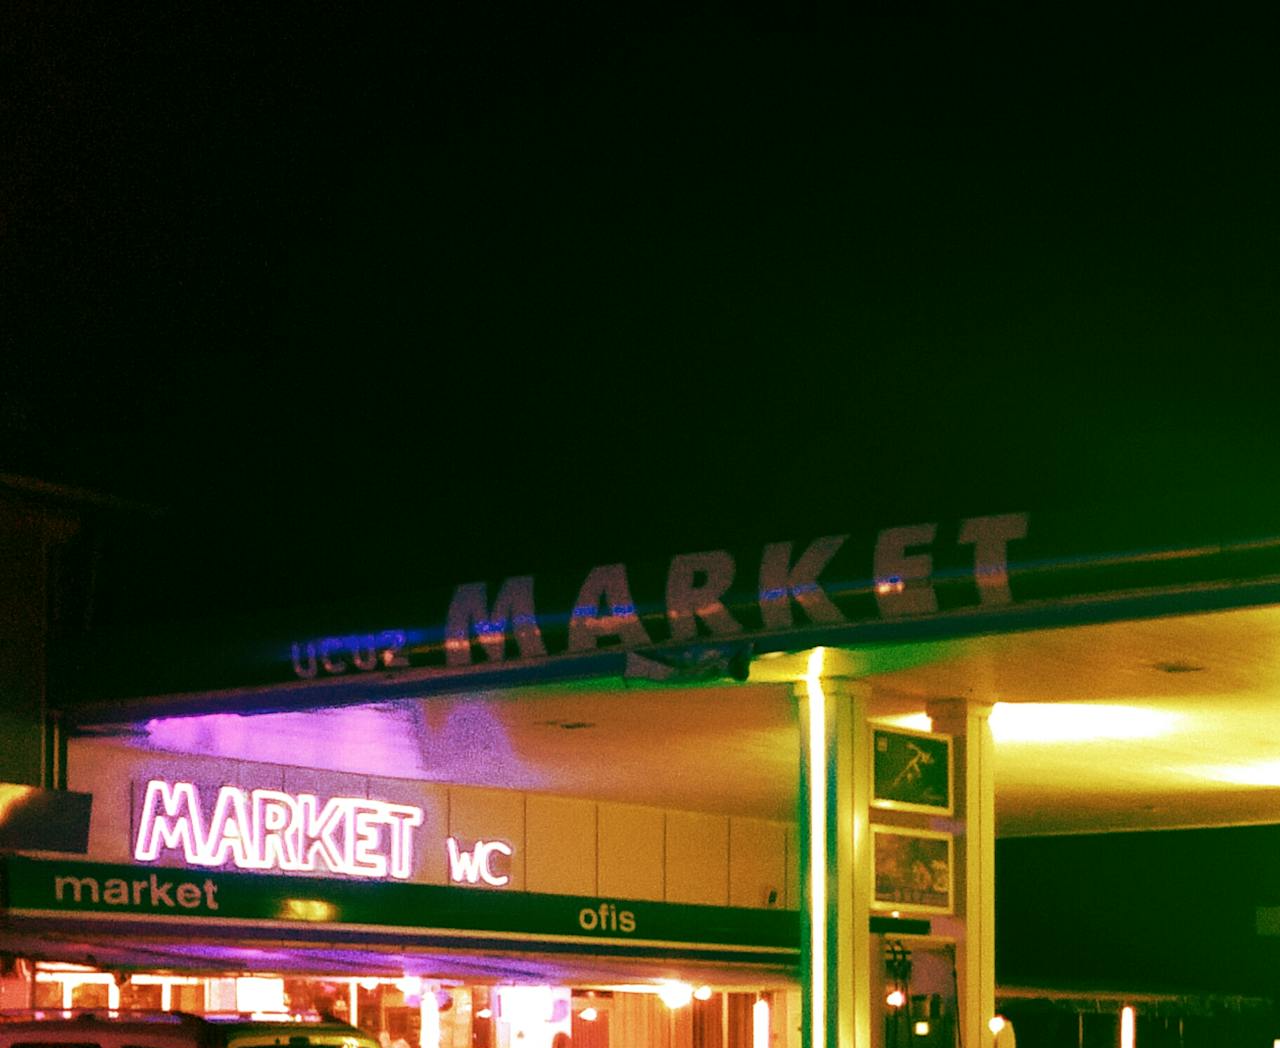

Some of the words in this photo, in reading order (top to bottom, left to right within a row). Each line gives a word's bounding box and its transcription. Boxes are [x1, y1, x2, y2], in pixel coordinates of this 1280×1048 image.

[444, 510, 1031, 666] MARKET
[133, 779, 425, 879] MARKET
[446, 835, 513, 887] WC
[54, 872, 219, 910] market
[578, 902, 637, 933] ofis
